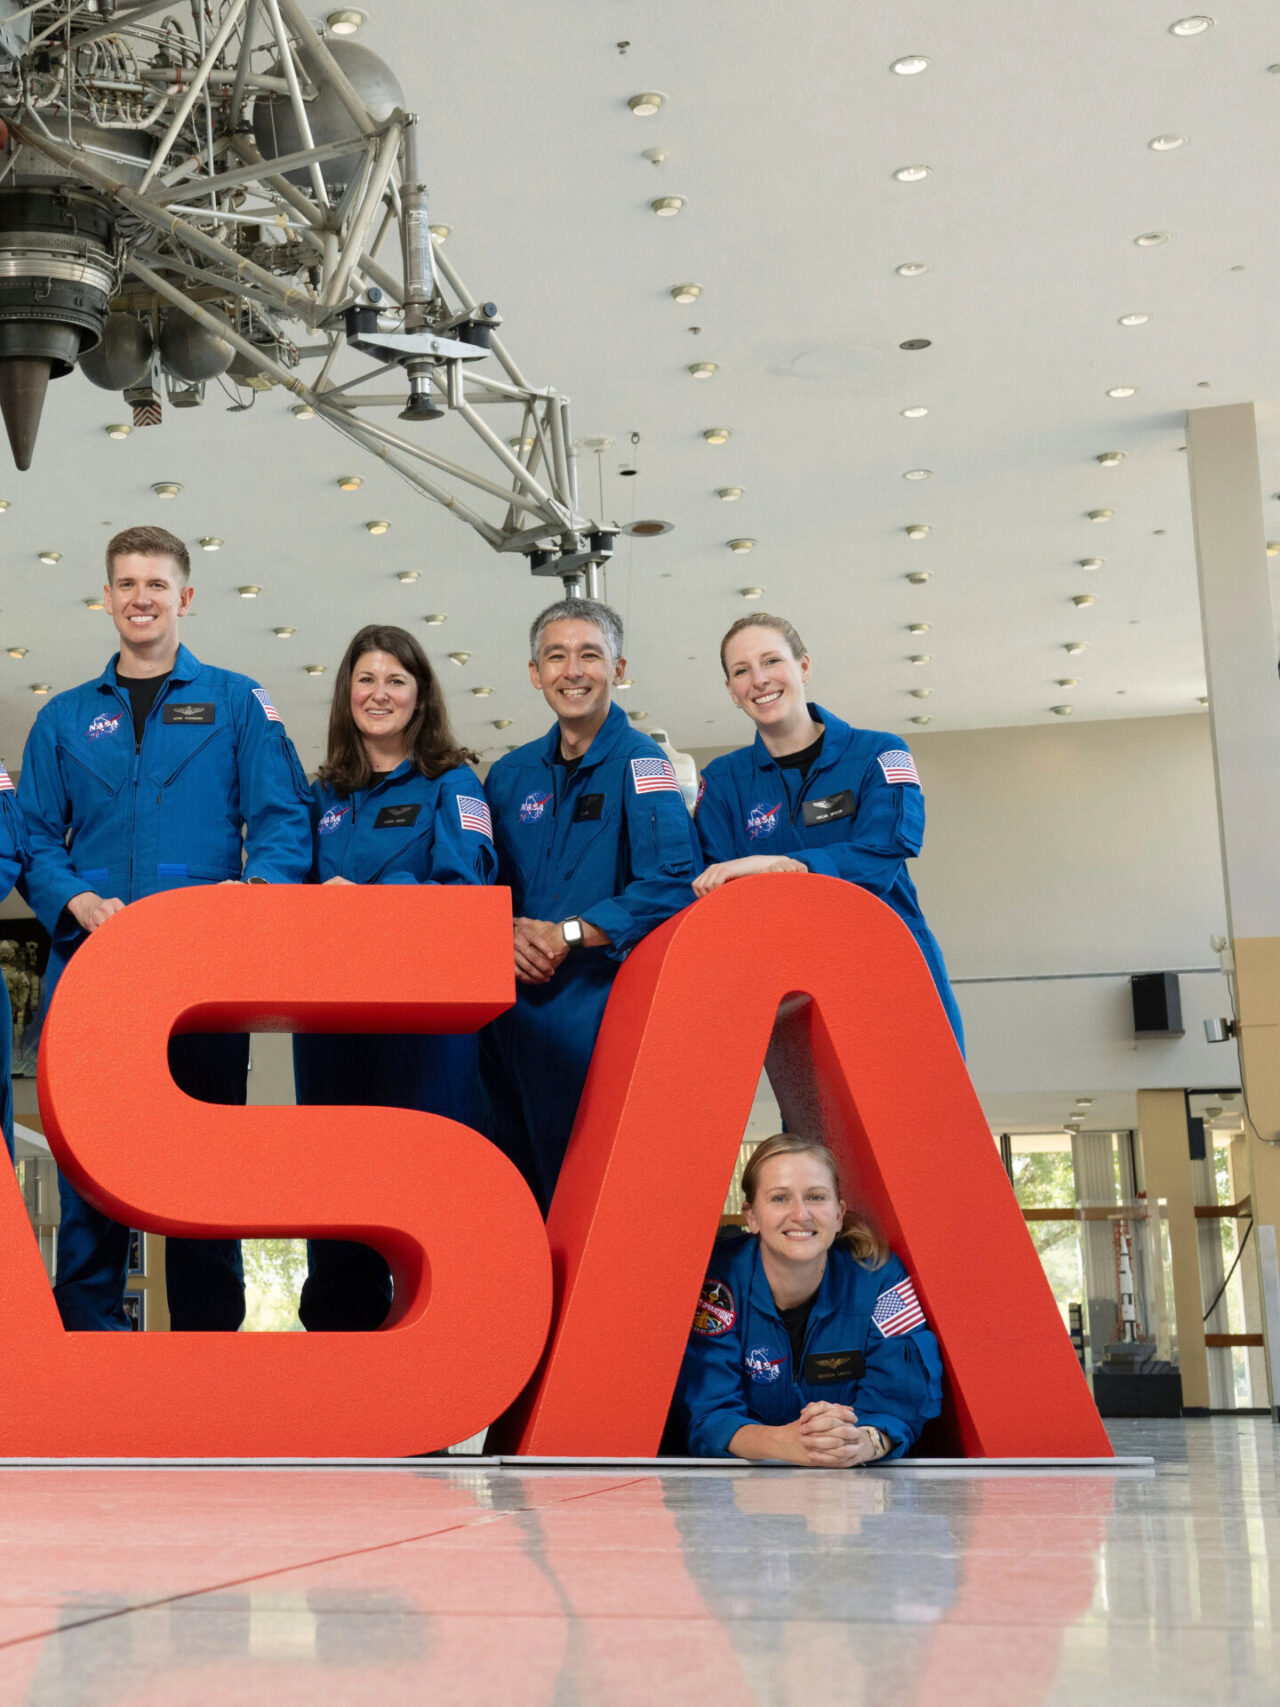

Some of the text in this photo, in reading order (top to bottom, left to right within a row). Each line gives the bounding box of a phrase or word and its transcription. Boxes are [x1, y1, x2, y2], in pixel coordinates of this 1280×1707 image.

[89, 719, 118, 732] NASA
[520, 802, 544, 812] NASA
[320, 815, 341, 825] NASA
[747, 814, 776, 828] NASA
[702, 1301, 734, 1326] OPERATIONS
[745, 1357, 780, 1374] NASA
